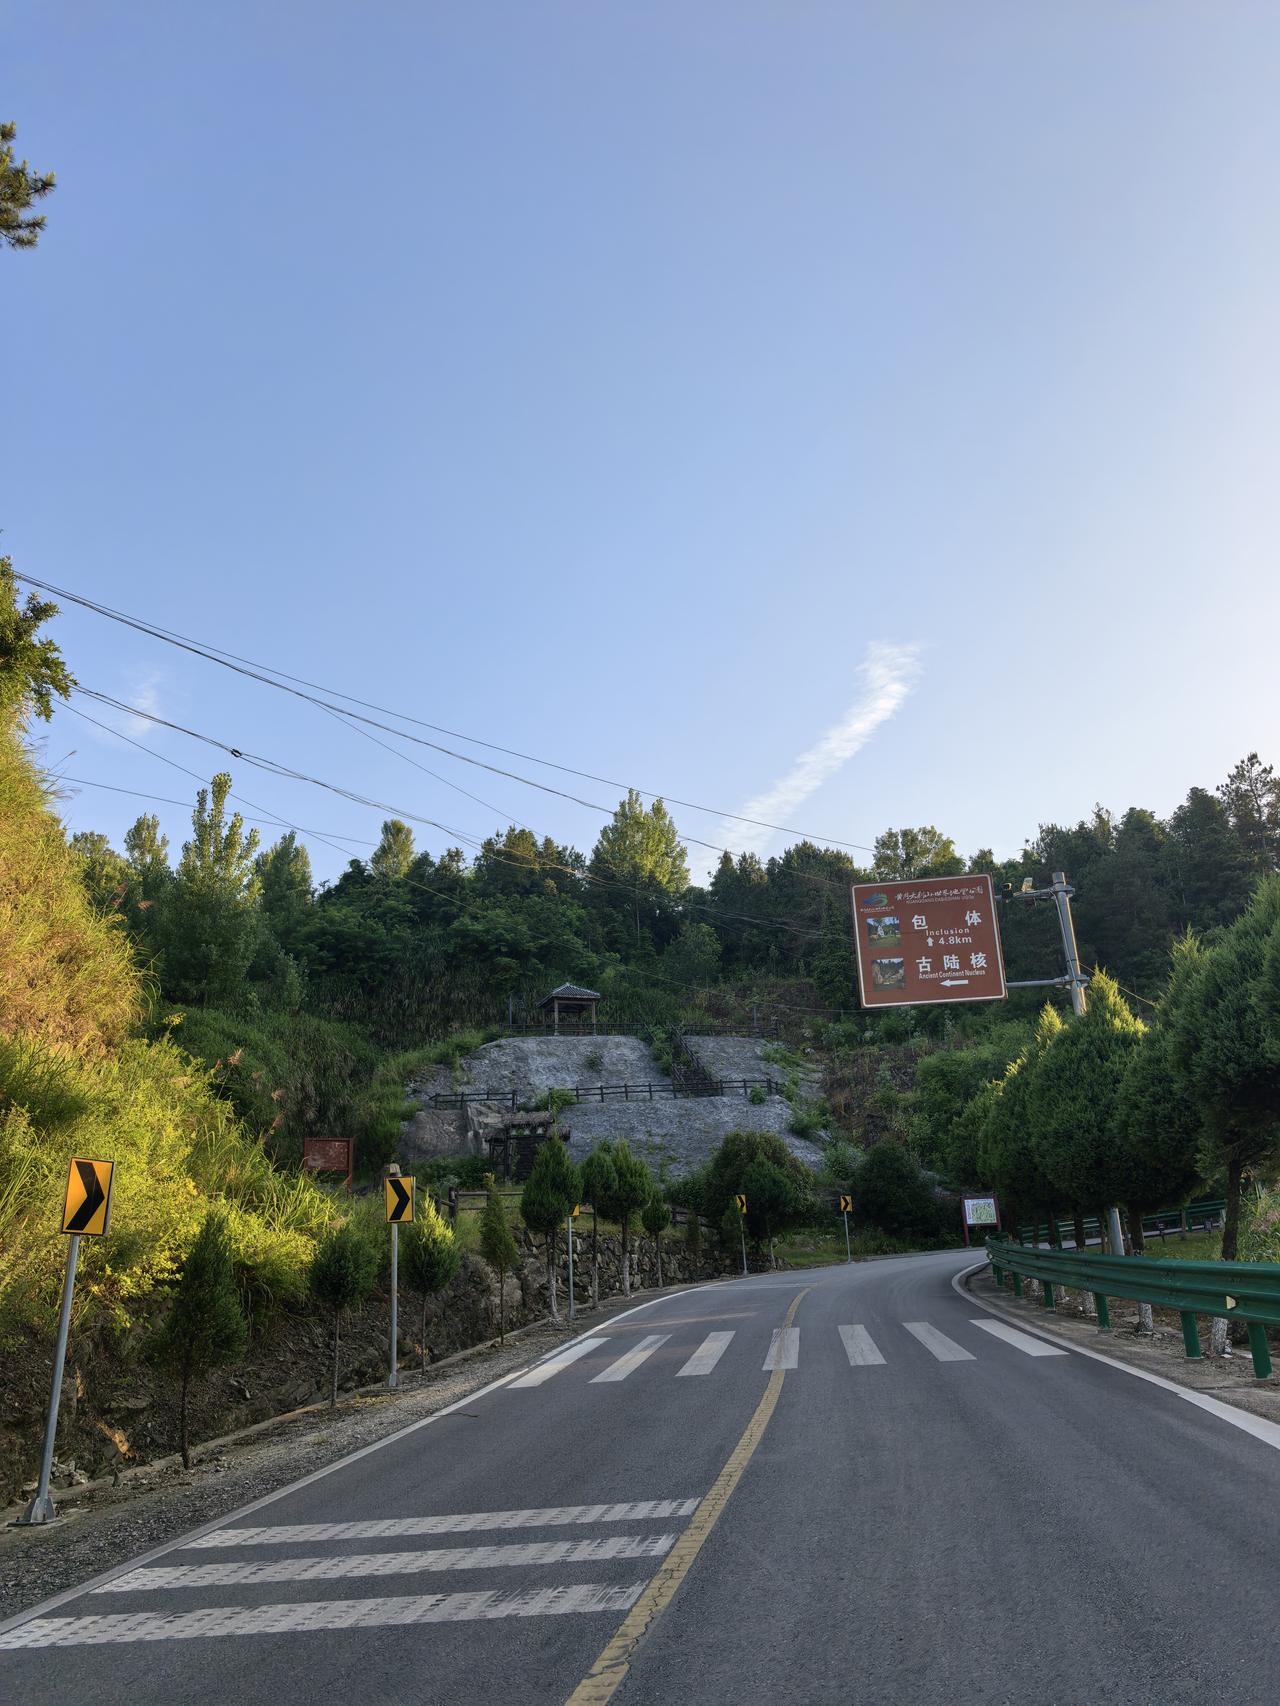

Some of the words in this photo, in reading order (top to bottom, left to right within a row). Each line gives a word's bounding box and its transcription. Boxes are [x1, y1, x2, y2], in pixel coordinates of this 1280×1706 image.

[926, 928, 970, 936] Inclusion
[938, 936, 972, 945] 4.8km
[915, 952, 988, 973] 古陆核
[938, 970, 964, 978] Continent
